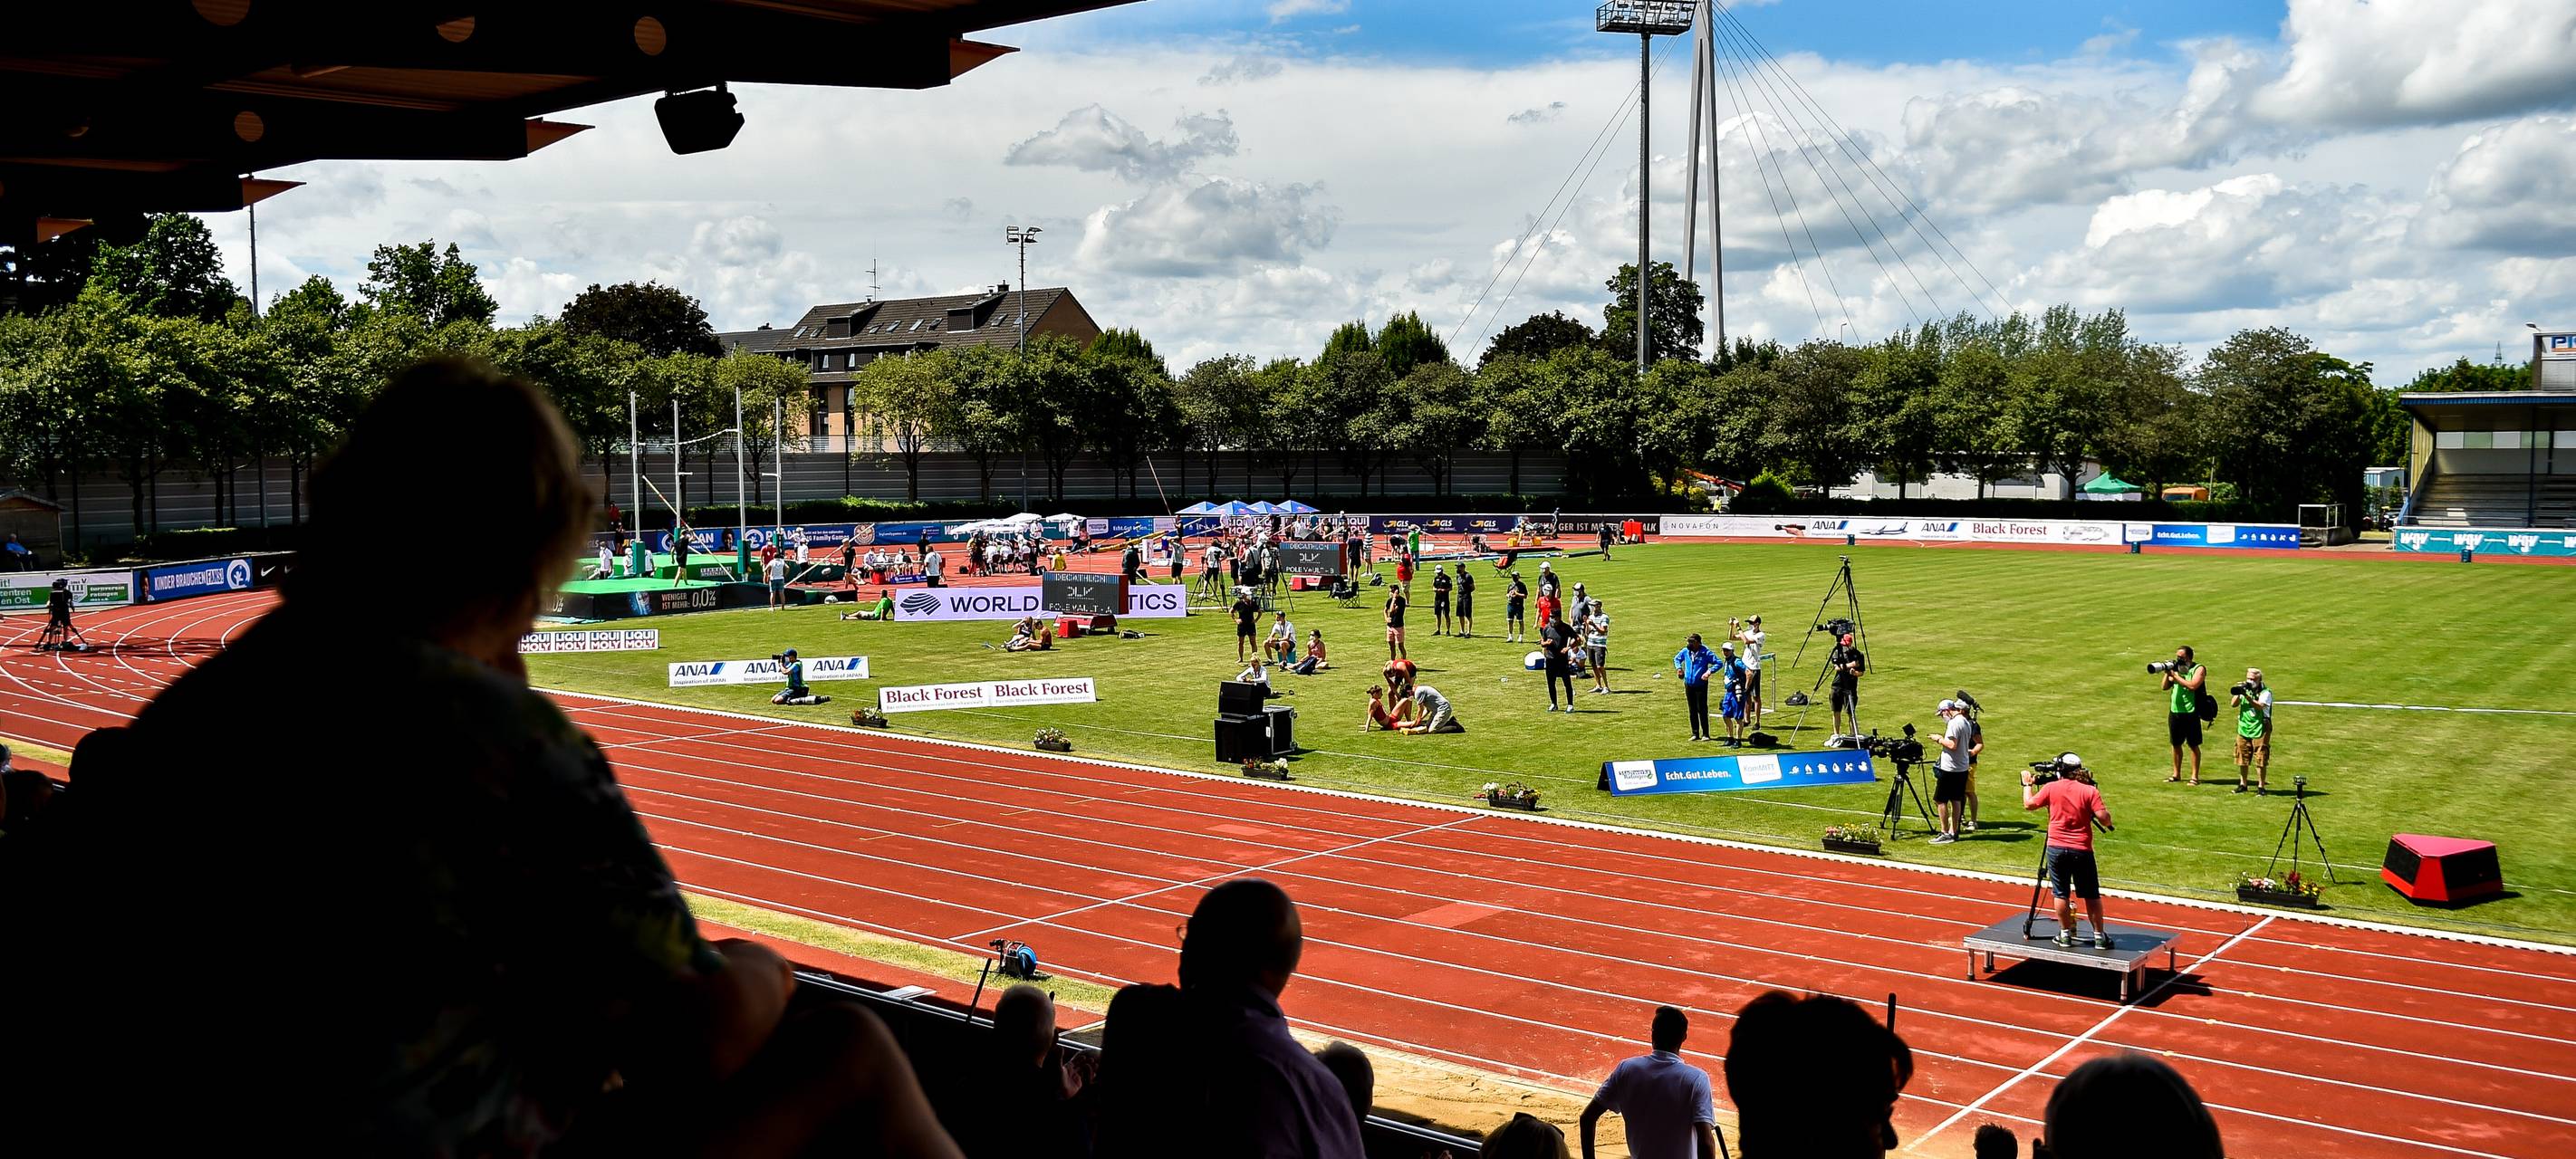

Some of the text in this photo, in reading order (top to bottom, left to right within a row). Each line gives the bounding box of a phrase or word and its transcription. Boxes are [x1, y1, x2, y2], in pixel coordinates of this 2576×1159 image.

[2551, 336, 2576, 349] PI
[1812, 521, 1836, 530] ANA
[1921, 522, 1945, 532] ANA
[1973, 522, 2047, 535] Black Forest
[155, 574, 175, 590] KINDER
[177, 570, 207, 589] BRAUCHEN
[1056, 573, 1105, 582] DECATHLON
[14, 597, 32, 605] Ost
[662, 593, 687, 601] WENIGER
[692, 589, 716, 608] 0,0%
[662, 600, 690, 609] IST MEHR:
[950, 596, 1039, 612] WORLD
[555, 632, 585, 642] LIQUI
[591, 631, 621, 641] LIQUI
[625, 630, 654, 640] LIQUI
[521, 642, 551, 651] MOLY
[555, 642, 586, 651] MOLY
[591, 640, 621, 650] MOLY
[625, 639, 655, 649] MOLY
[675, 665, 707, 676] ANA
[745, 662, 776, 674] ANA
[812, 660, 844, 672] ANA
[995, 681, 1090, 698] Black Forest
[887, 690, 930, 704] Black
[935, 686, 983, 701] Forest
[1665, 770, 1732, 781] Echt.Gut.Leben.
